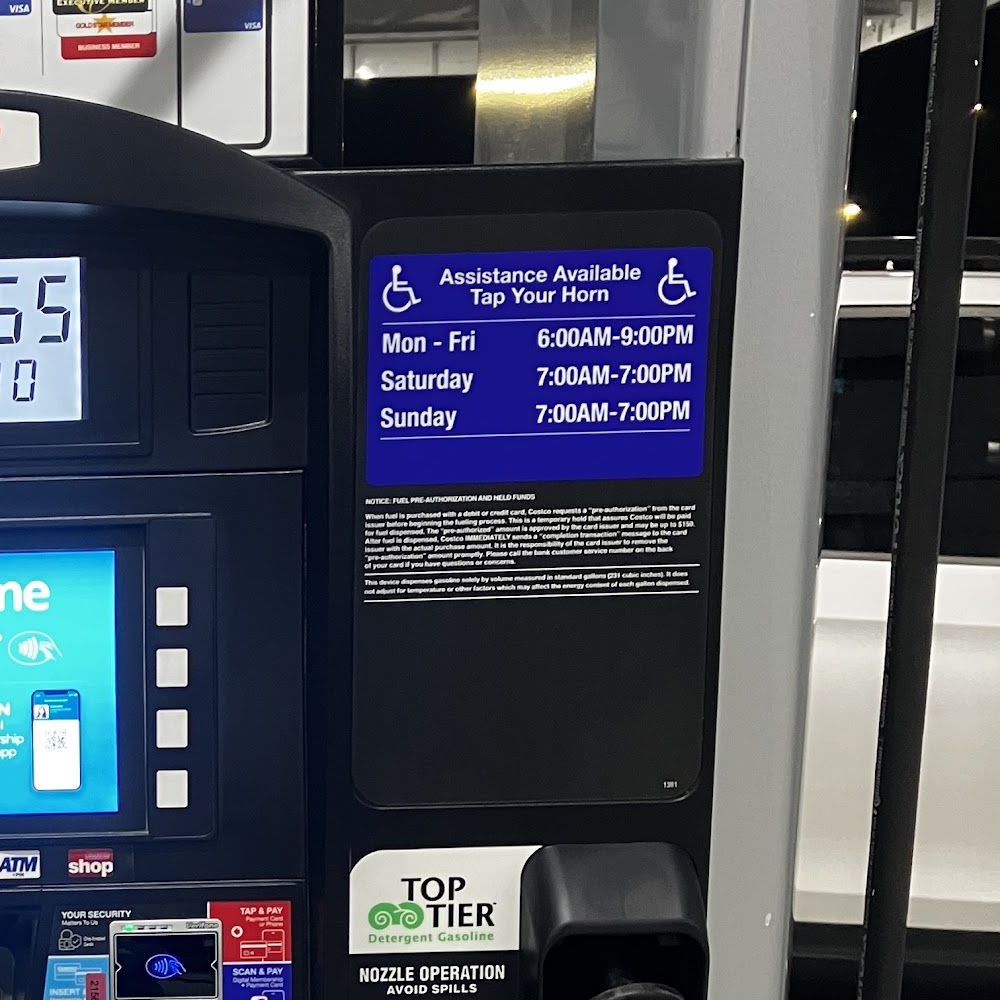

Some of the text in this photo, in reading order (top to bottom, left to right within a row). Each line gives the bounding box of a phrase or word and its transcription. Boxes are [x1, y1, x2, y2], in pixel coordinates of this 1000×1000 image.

[10, 4, 29, 13] VISA
[245, 22, 263, 31] VISA
[440, 264, 641, 285] Assistance Available
[470, 286, 608, 308] Tap Your Horn
[383, 333, 426, 353] Mon
[449, 330, 475, 351] Fri
[538, 325, 693, 348] 6:00AM-9:00PM
[381, 363, 691, 393] Saturday 7:00AM-7:00PM
[381, 400, 690, 430] Sunday 7:00AM-7:00PM
[68, 858, 113, 878] shop
[401, 877, 465, 901] TOP
[61, 910, 131, 919] YOUR SECURITY
[240, 907, 283, 915] TAP & PAY
[426, 903, 495, 927] TIER
[368, 932, 494, 944] Detergent Gasoline
[233, 968, 256, 976] SCAN
[360, 965, 505, 982] NOZZLE OPERATION
[387, 984, 477, 994] AVOID SPILLS
